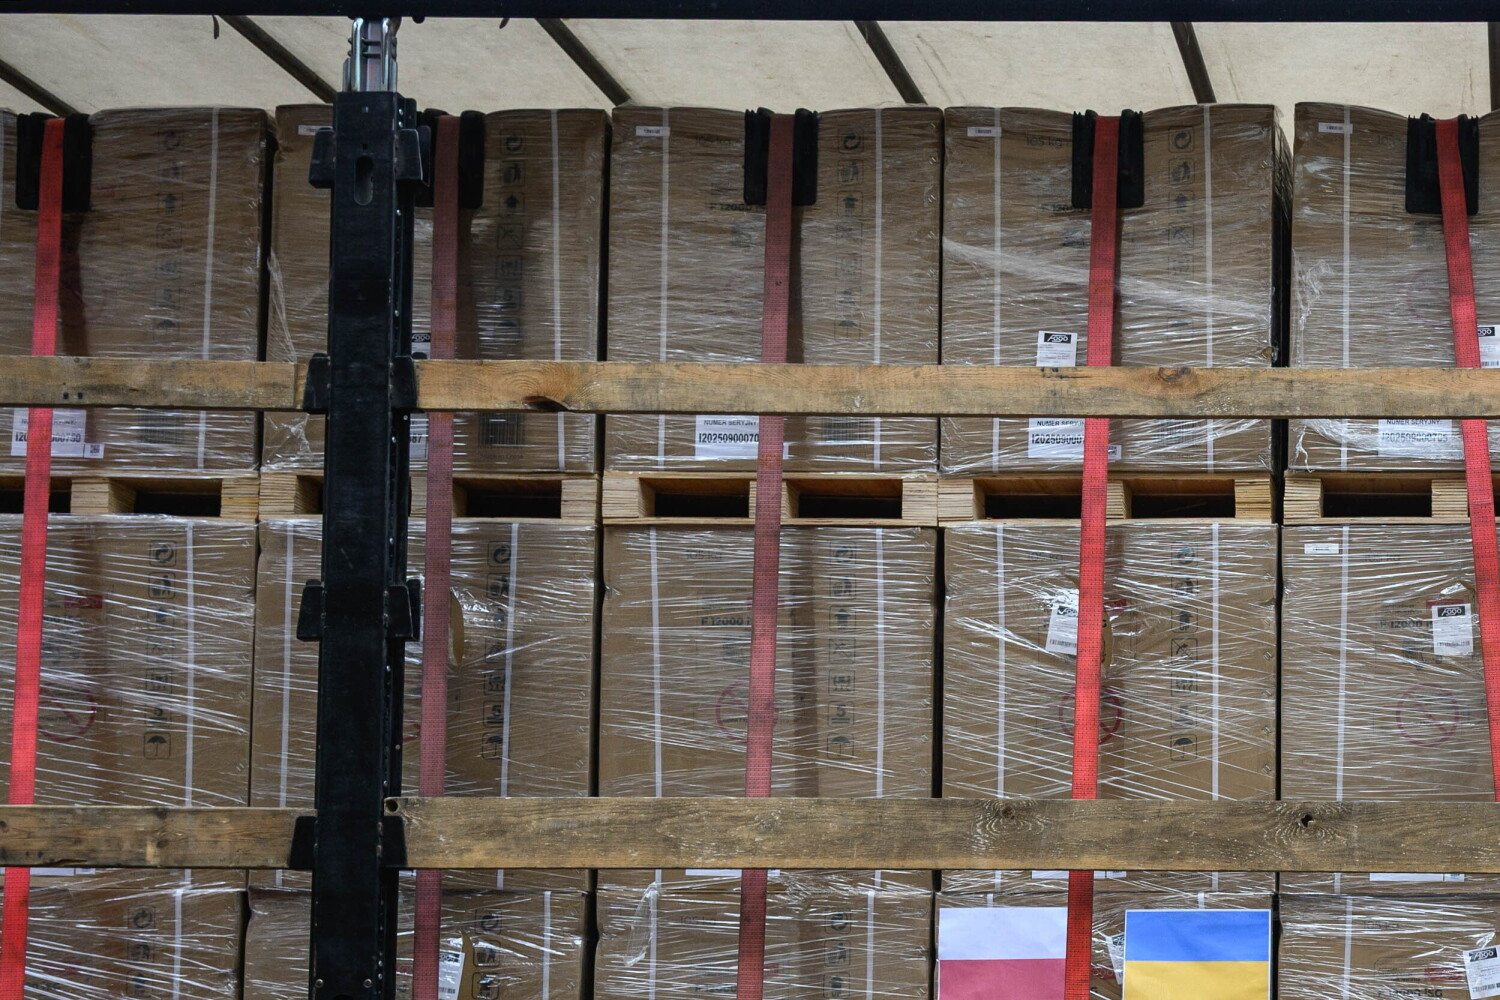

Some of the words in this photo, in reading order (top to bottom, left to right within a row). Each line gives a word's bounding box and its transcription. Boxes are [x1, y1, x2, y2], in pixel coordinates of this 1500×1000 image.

[1047, 334, 1070, 343] Fogo
[699, 433, 759, 443] I20250900070
[1441, 608, 1464, 617] Fogo
